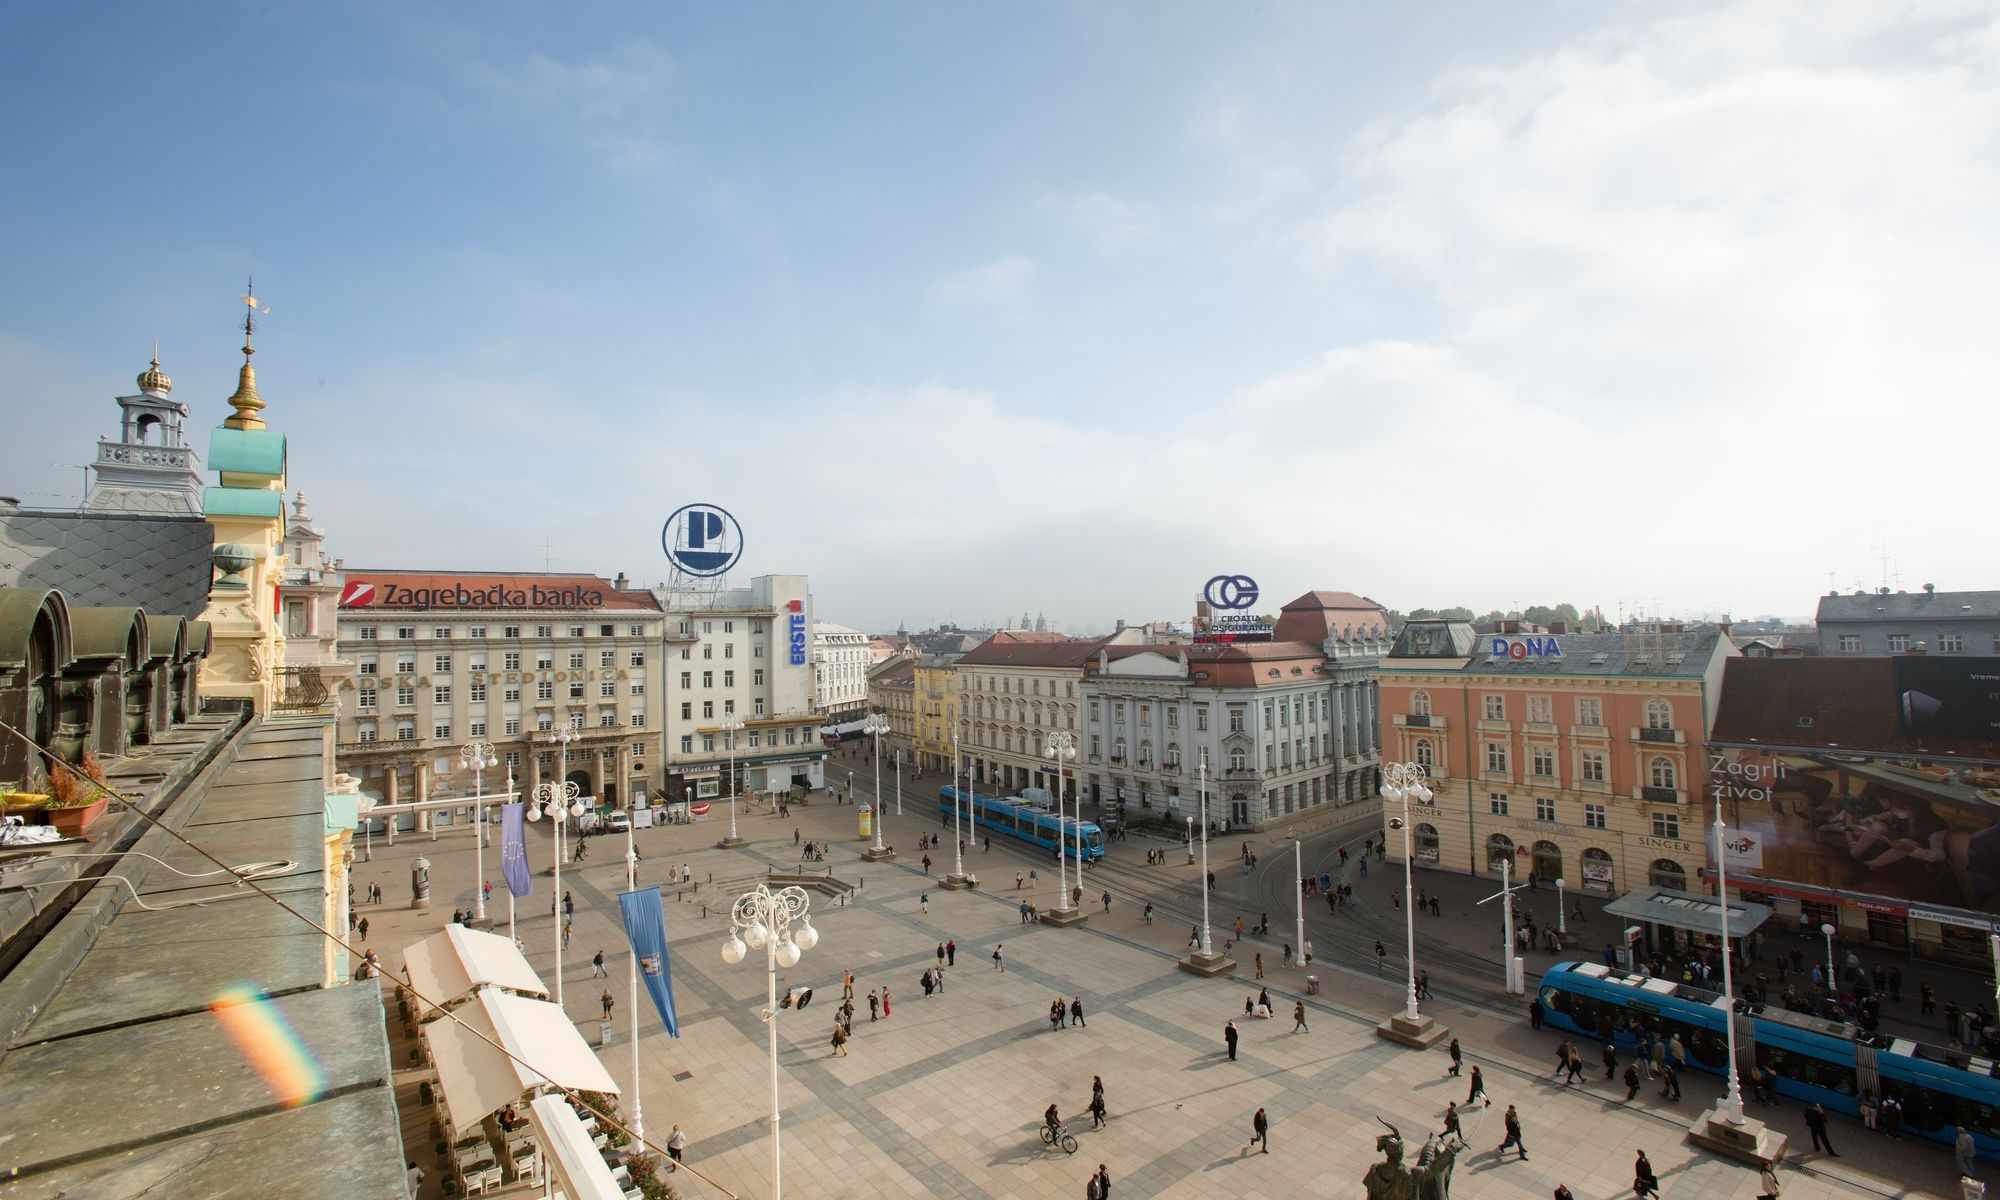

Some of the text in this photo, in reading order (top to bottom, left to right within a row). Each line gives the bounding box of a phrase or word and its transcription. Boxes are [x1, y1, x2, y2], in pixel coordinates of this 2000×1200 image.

[384, 583, 602, 609] Zagrebačka banka
[1211, 624, 1272, 632] OSIGURANJE
[789, 615, 806, 665] ERSTE
[1492, 638, 1562, 660] DONA
[339, 675, 432, 691] ADSKA
[1710, 754, 1786, 782] Zagrli
[1407, 805, 1442, 817] SINGER
[1638, 837, 1690, 852] SINGER
[1726, 841, 1748, 854] vip
